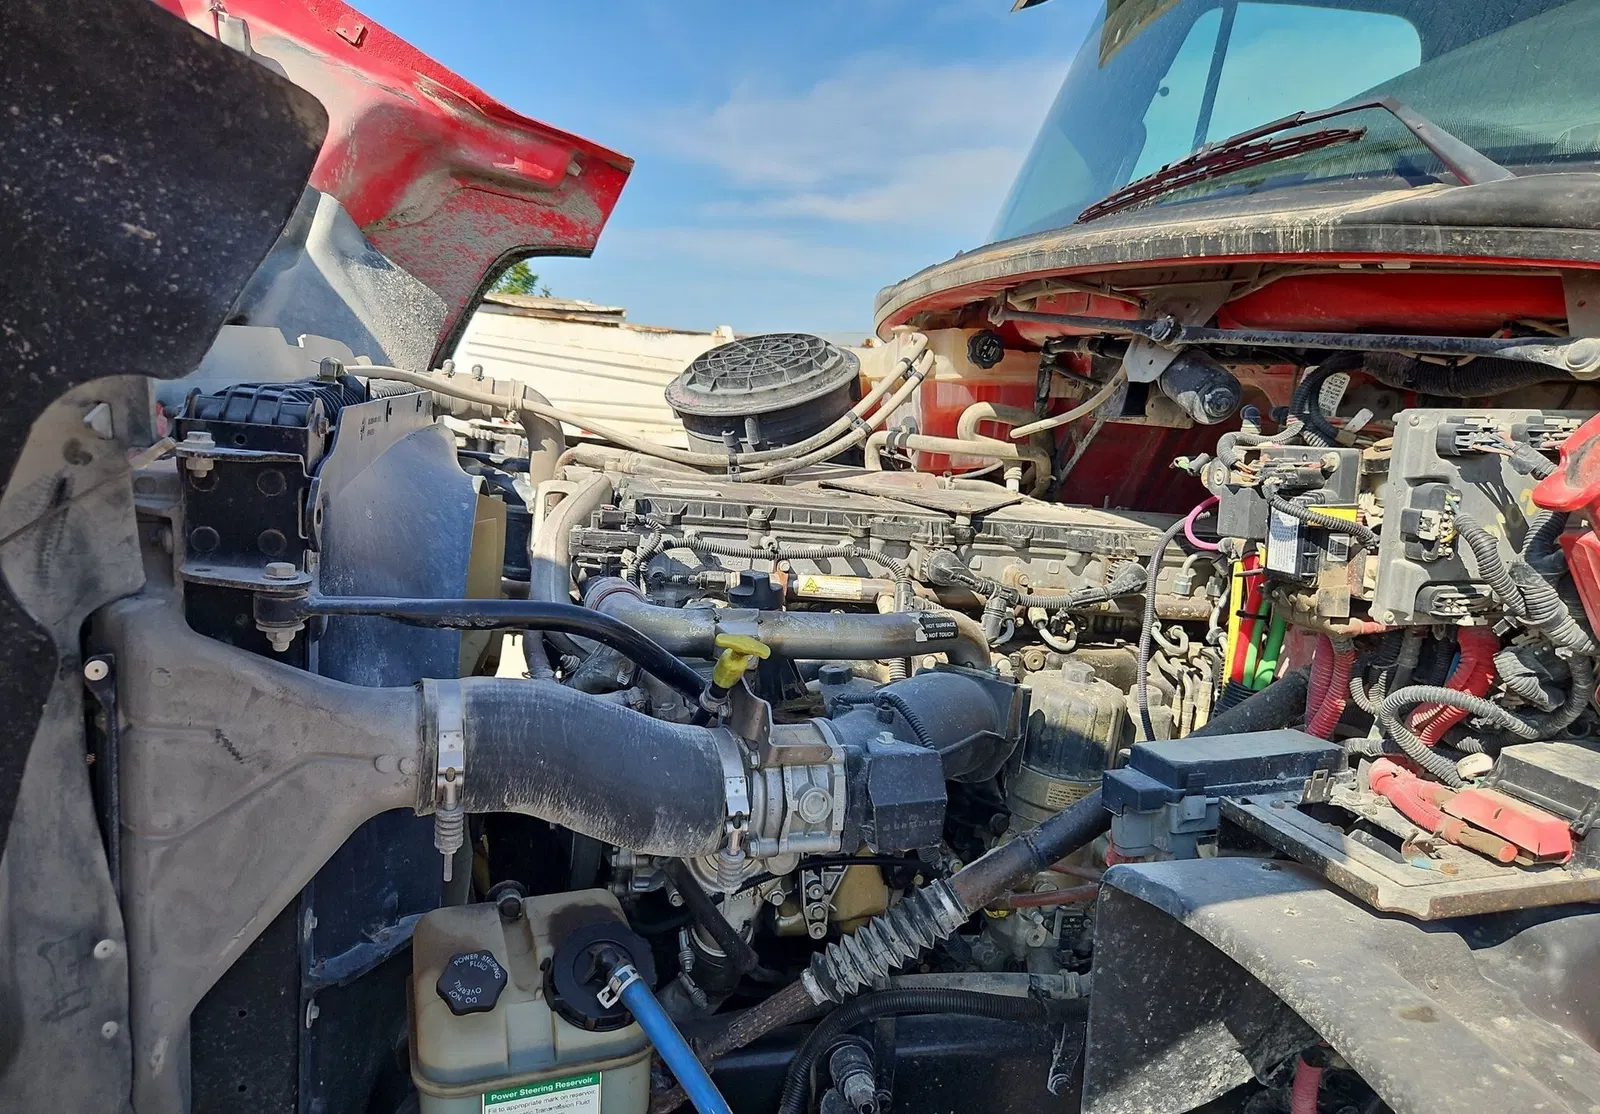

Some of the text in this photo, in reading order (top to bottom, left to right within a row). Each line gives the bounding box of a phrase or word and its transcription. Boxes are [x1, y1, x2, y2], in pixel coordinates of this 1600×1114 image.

[454, 953, 501, 979] POWER STEERING
[470, 961, 488, 971] FLUID
[454, 980, 482, 996] OVERFILL
[449, 990, 463, 1002] NOT
[491, 1077, 593, 1101] Power Steering Reservoir
[506, 1099, 542, 1111] appropriate
[543, 1096, 559, 1104] mark
